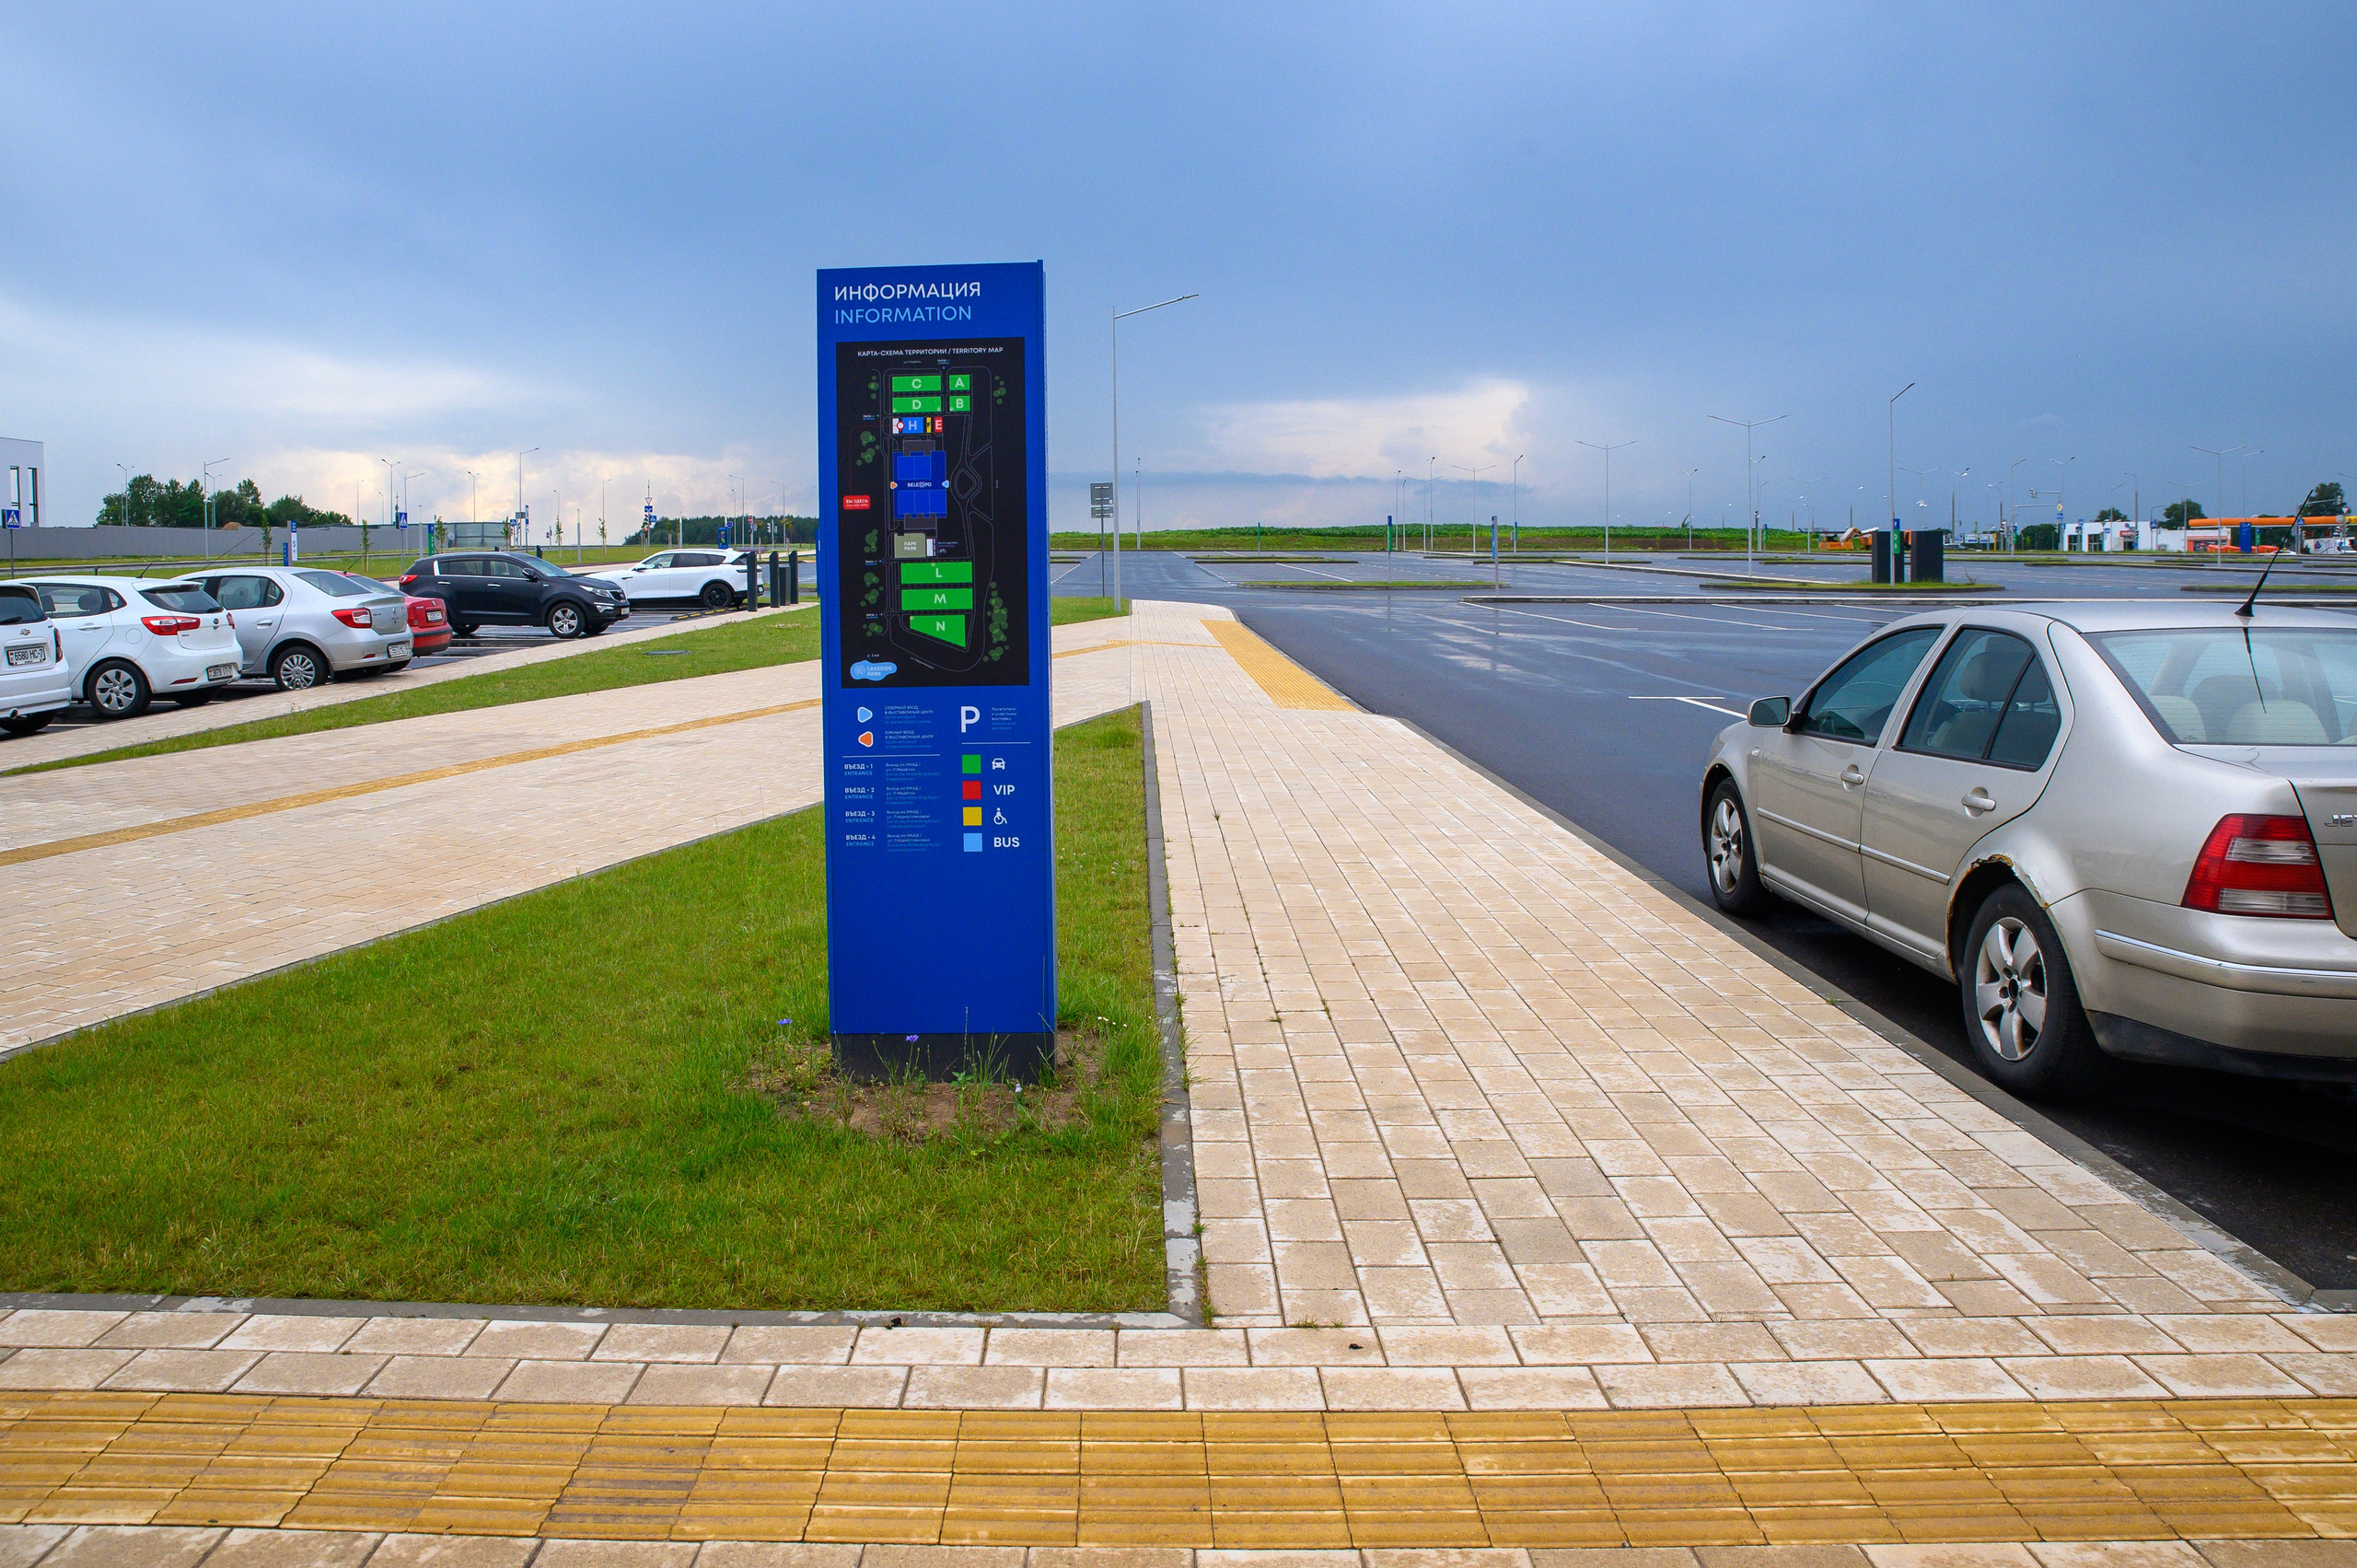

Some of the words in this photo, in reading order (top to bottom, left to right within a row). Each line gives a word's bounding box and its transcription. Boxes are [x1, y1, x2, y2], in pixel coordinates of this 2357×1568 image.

[835, 282, 981, 302] ИНФОРМАЦИЯ
[835, 306, 971, 324] INFORMATION
[857, 349, 904, 357] КАРТА-СХЕМА
[911, 378, 922, 389] C
[955, 377, 965, 388] A
[912, 400, 922, 410] D
[956, 399, 964, 409] B
[909, 420, 917, 431] H
[935, 420, 942, 430] E
[935, 567, 942, 578] L
[935, 594, 946, 604] M
[936, 621, 946, 632] N
[960, 706, 981, 733] P
[993, 784, 1016, 796] VIP
[2324, 814, 2357, 827] JE
[993, 837, 1020, 848] BUS
